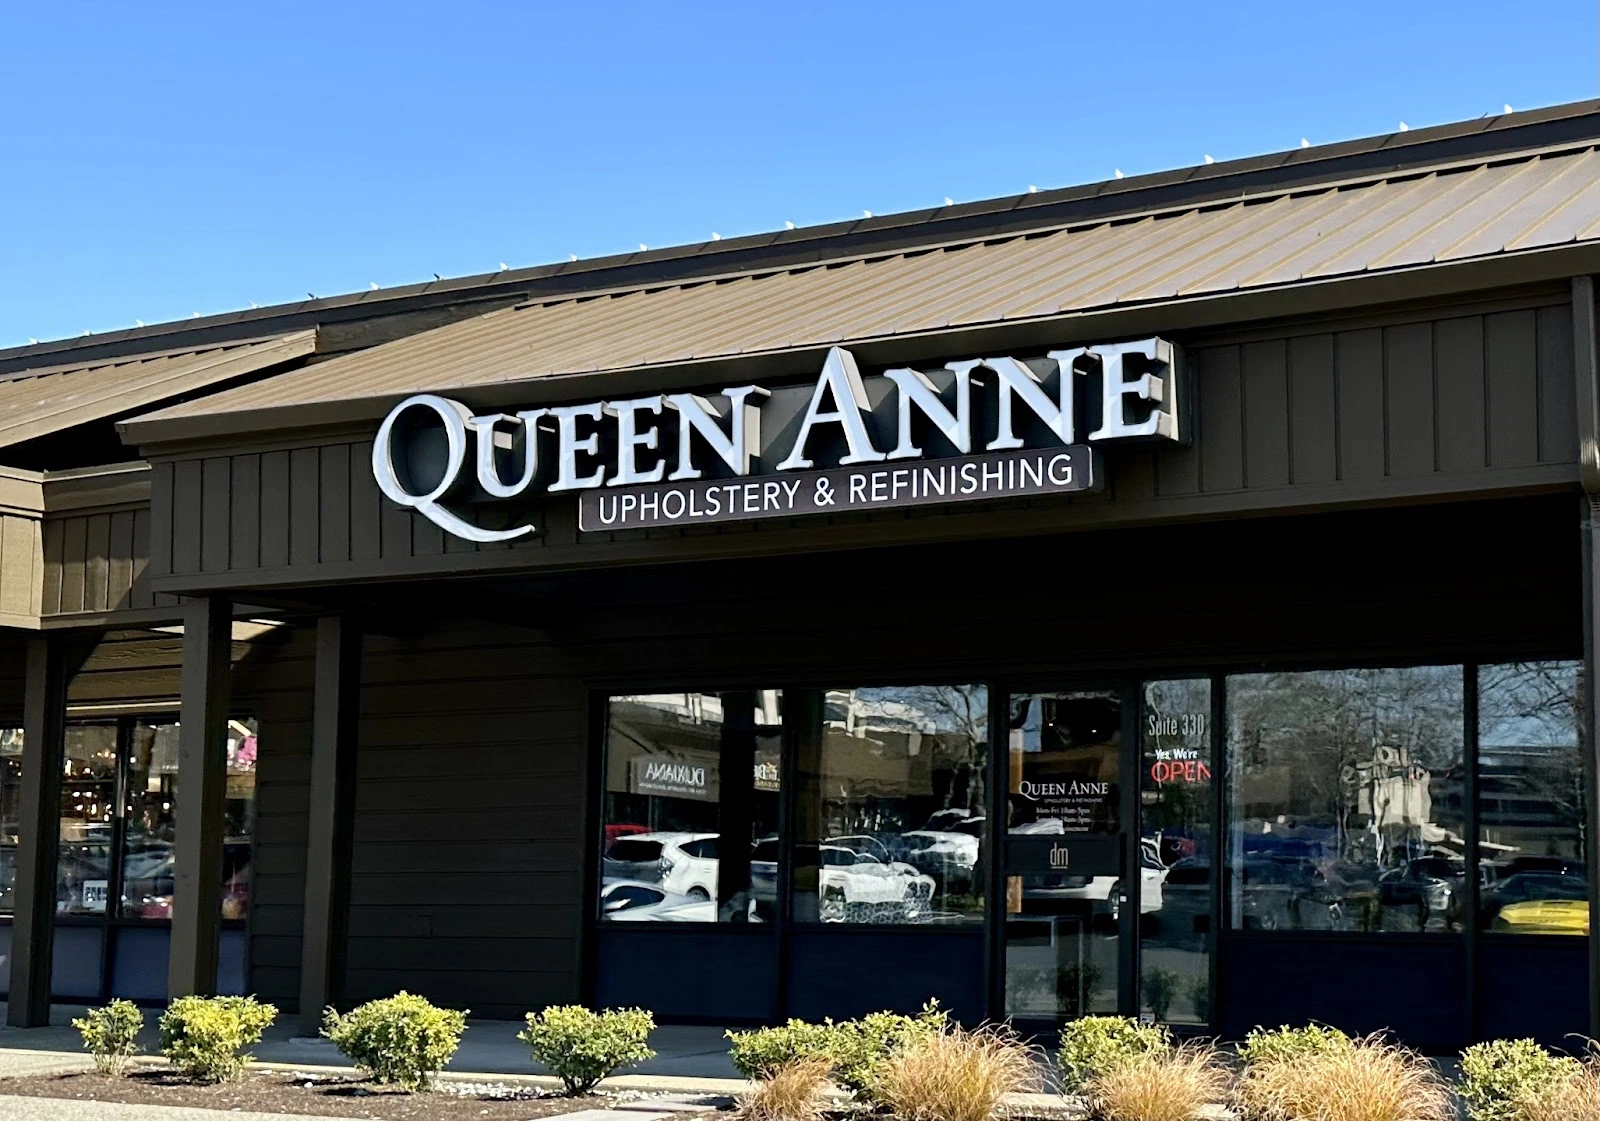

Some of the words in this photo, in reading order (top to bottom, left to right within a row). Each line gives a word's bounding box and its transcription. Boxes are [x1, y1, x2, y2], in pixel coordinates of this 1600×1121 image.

[372, 385, 770, 543] QUEEN
[776, 336, 1175, 471] ANNE
[599, 479, 801, 524] UPHOLSTERY
[813, 477, 835, 506] &
[849, 454, 1072, 504] REFINISHING
[1148, 714, 1178, 736] Suite
[1181, 713, 1205, 736] 330
[1173, 747, 1198, 760] We're
[1150, 760, 1212, 782] OPEN
[1018, 780, 1066, 801] QUEEN
[1068, 779, 1109, 795] ANNE
[1050, 841, 1068, 865] dm
